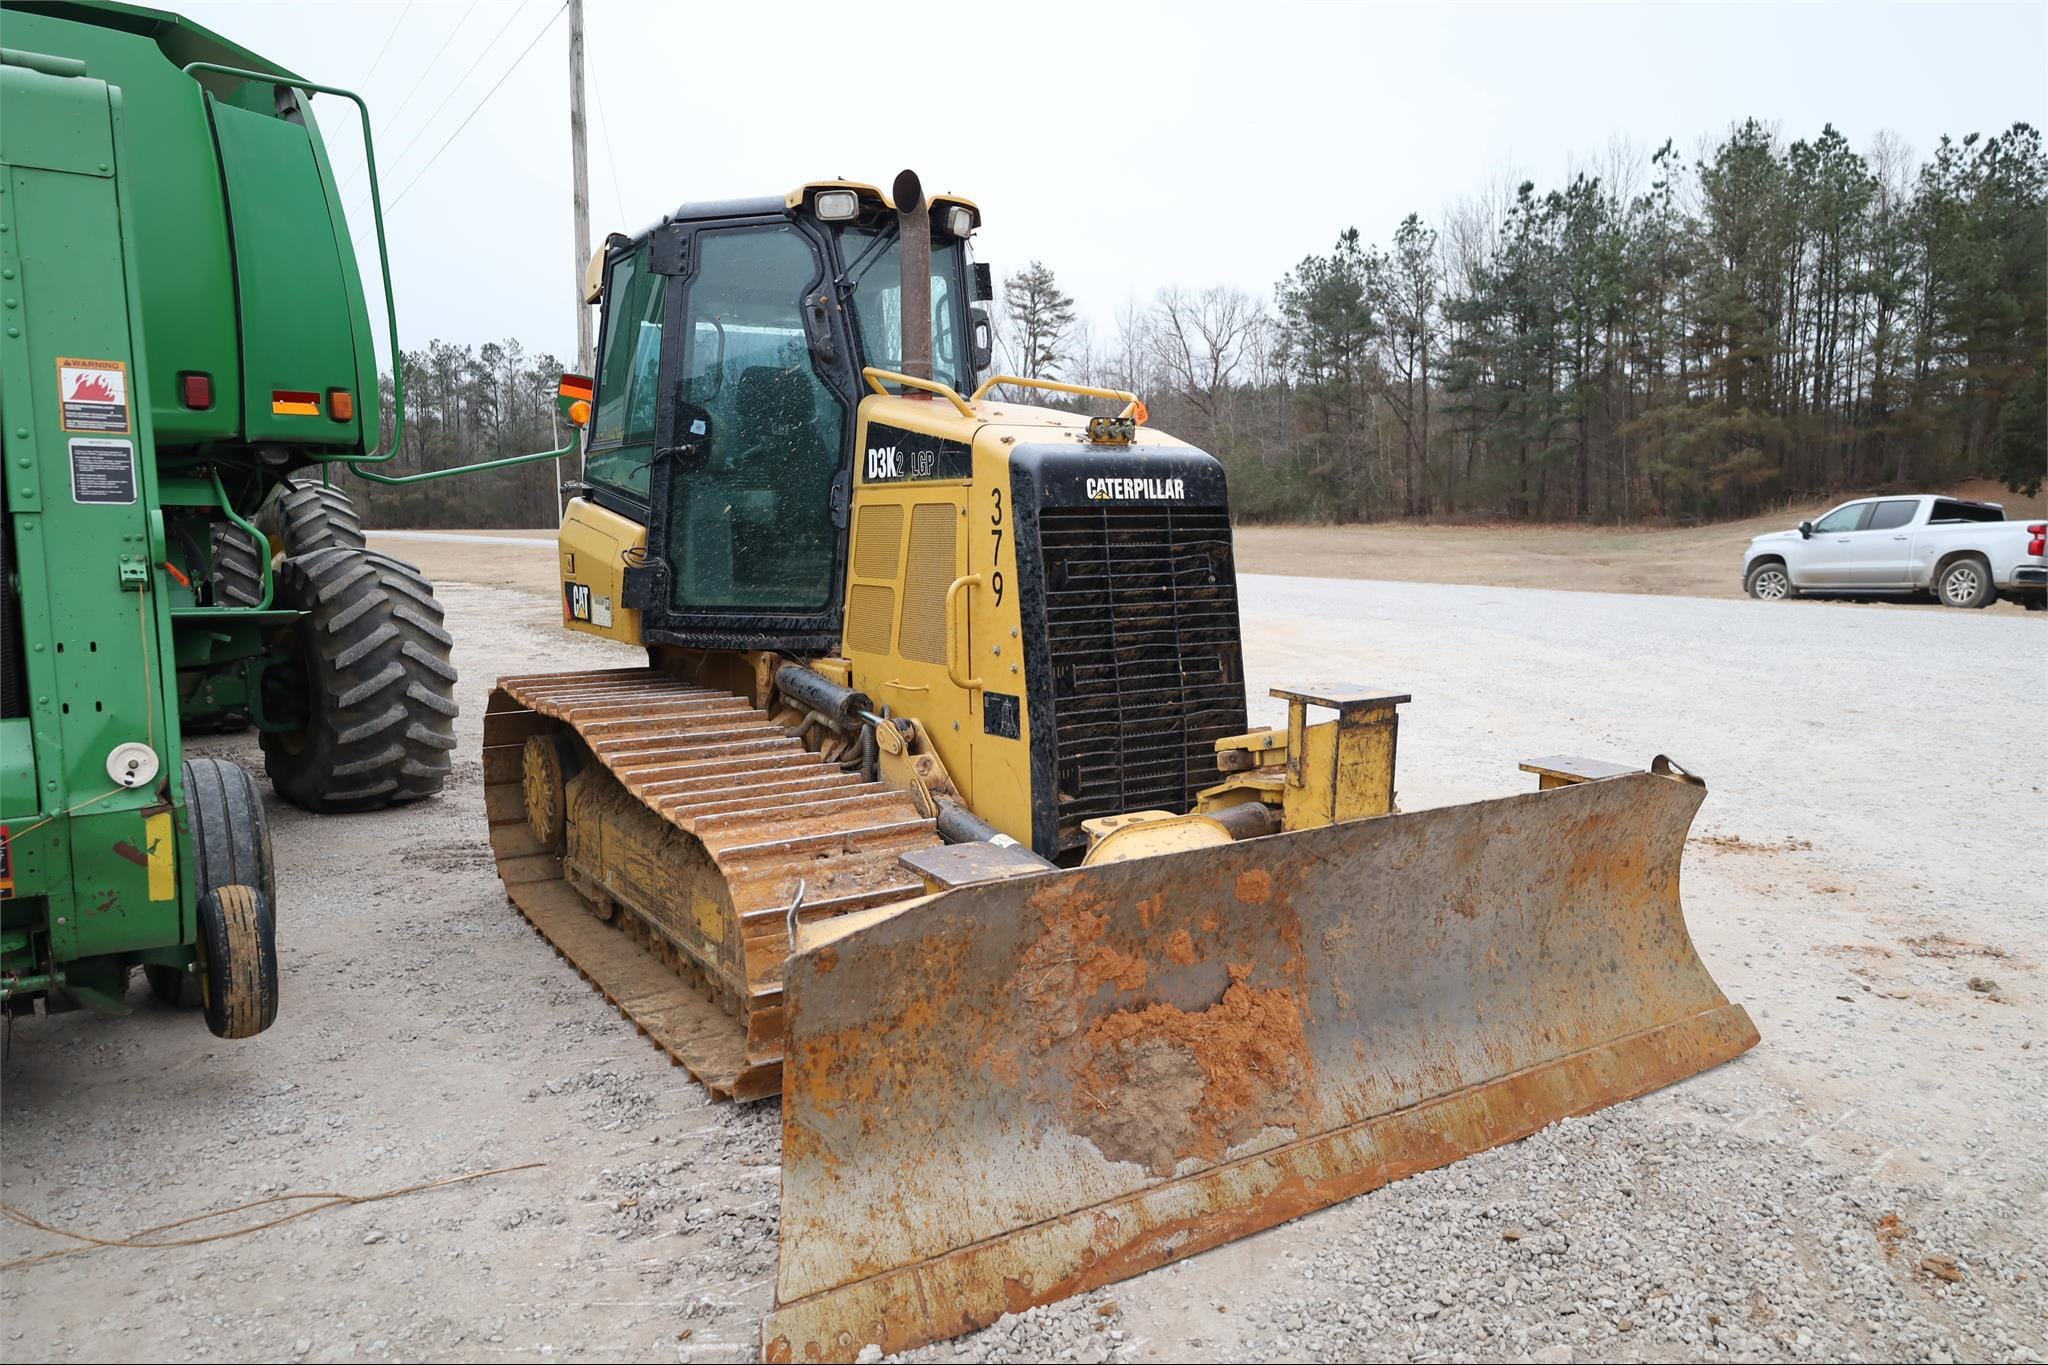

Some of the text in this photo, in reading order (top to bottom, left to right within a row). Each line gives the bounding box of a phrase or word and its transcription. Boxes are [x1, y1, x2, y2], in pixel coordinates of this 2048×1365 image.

[72, 361, 119, 369] WARNING
[911, 451, 934, 476] LGP
[1086, 478, 1185, 500] CATERPILLAR
[573, 585, 588, 619] CAT
